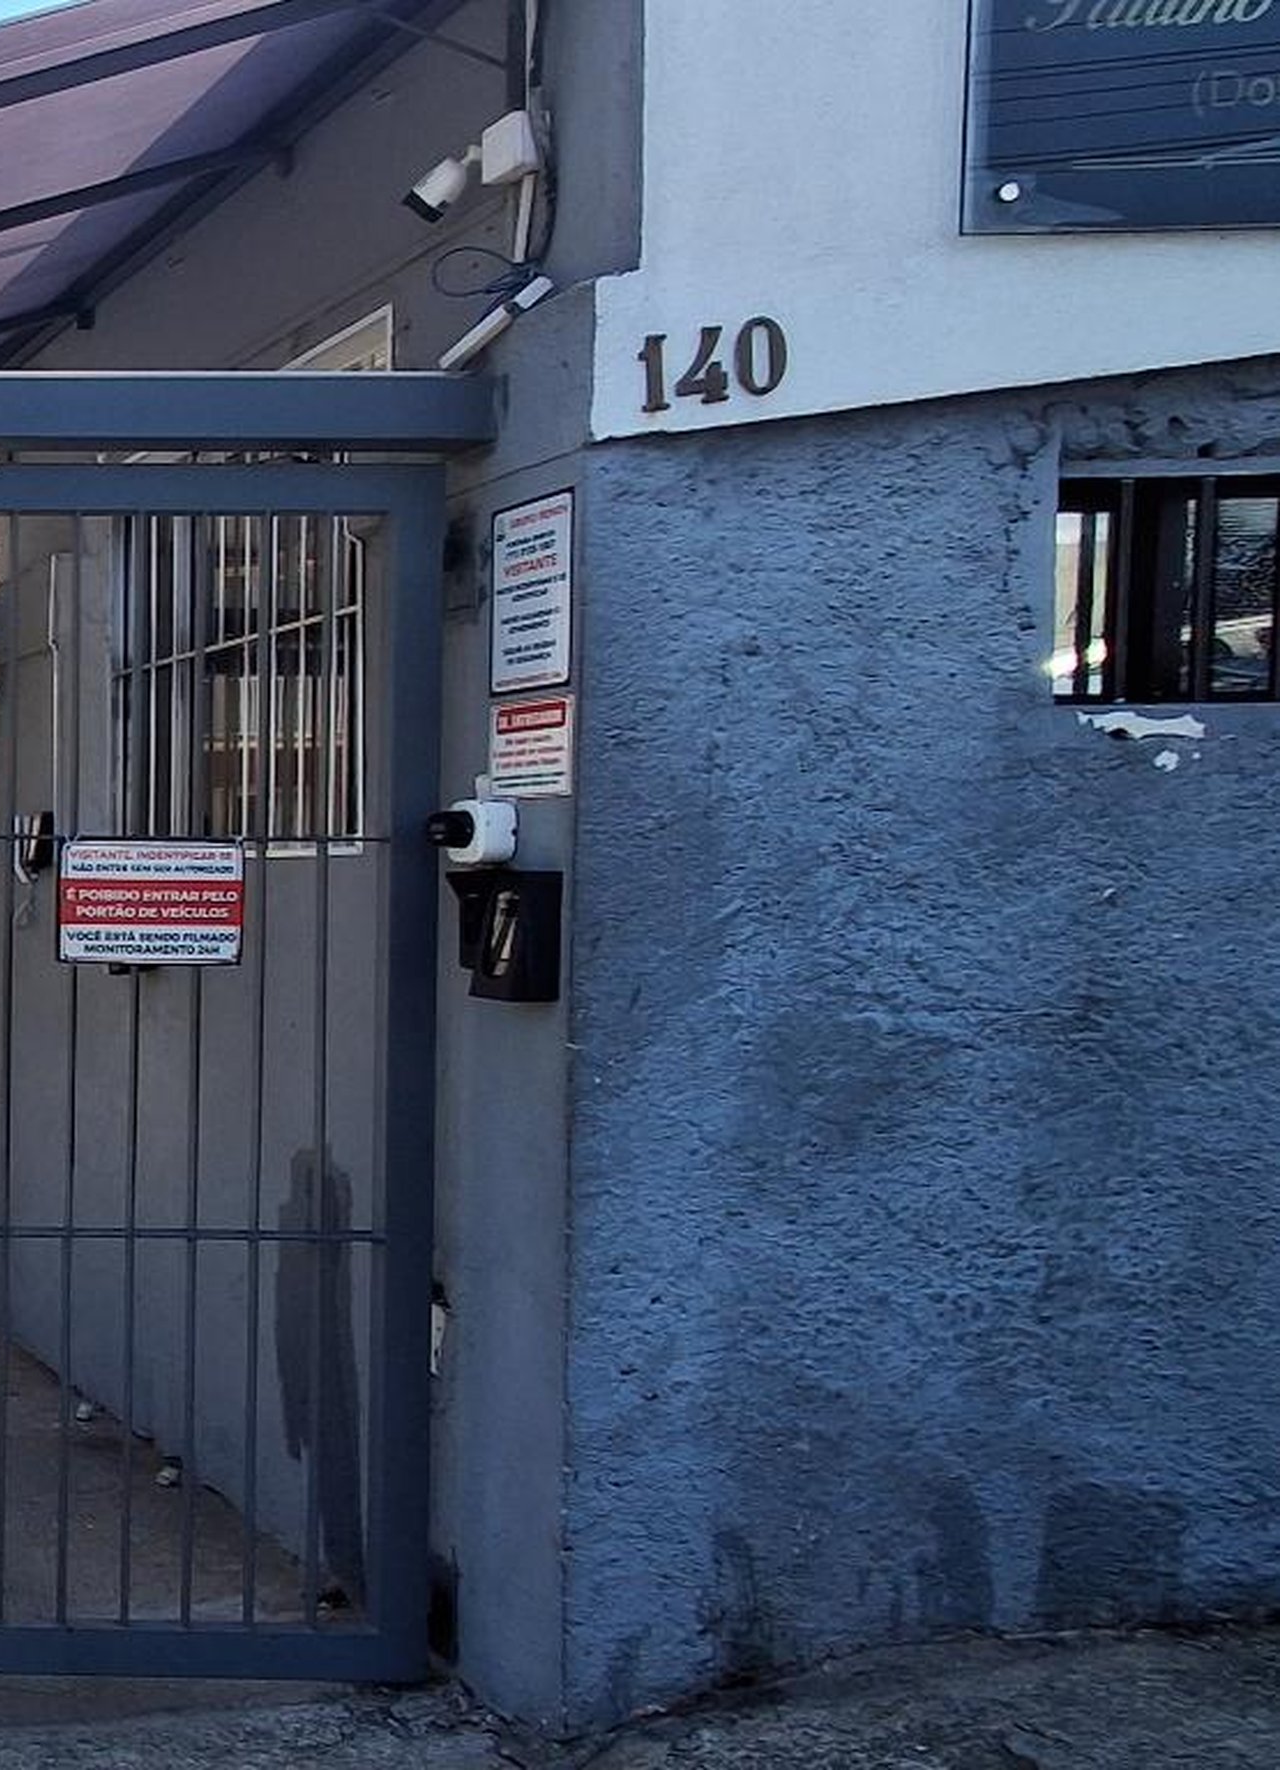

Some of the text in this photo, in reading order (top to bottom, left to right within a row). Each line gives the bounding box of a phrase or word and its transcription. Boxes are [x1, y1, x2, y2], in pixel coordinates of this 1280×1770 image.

[1192, 70, 1280, 118] (Do
[638, 316, 788, 413] 140
[71, 862, 93, 872] NÃO
[142, 889, 200, 902] ENTRAR
[202, 891, 238, 902] PELO
[76, 903, 229, 919] PORTÃO DE VEÍCULOS
[66, 930, 101, 941] VOCÊ
[139, 932, 180, 942] SENDO
[183, 932, 237, 943] FILMADO
[84, 943, 195, 955] MONITORAMENTO
